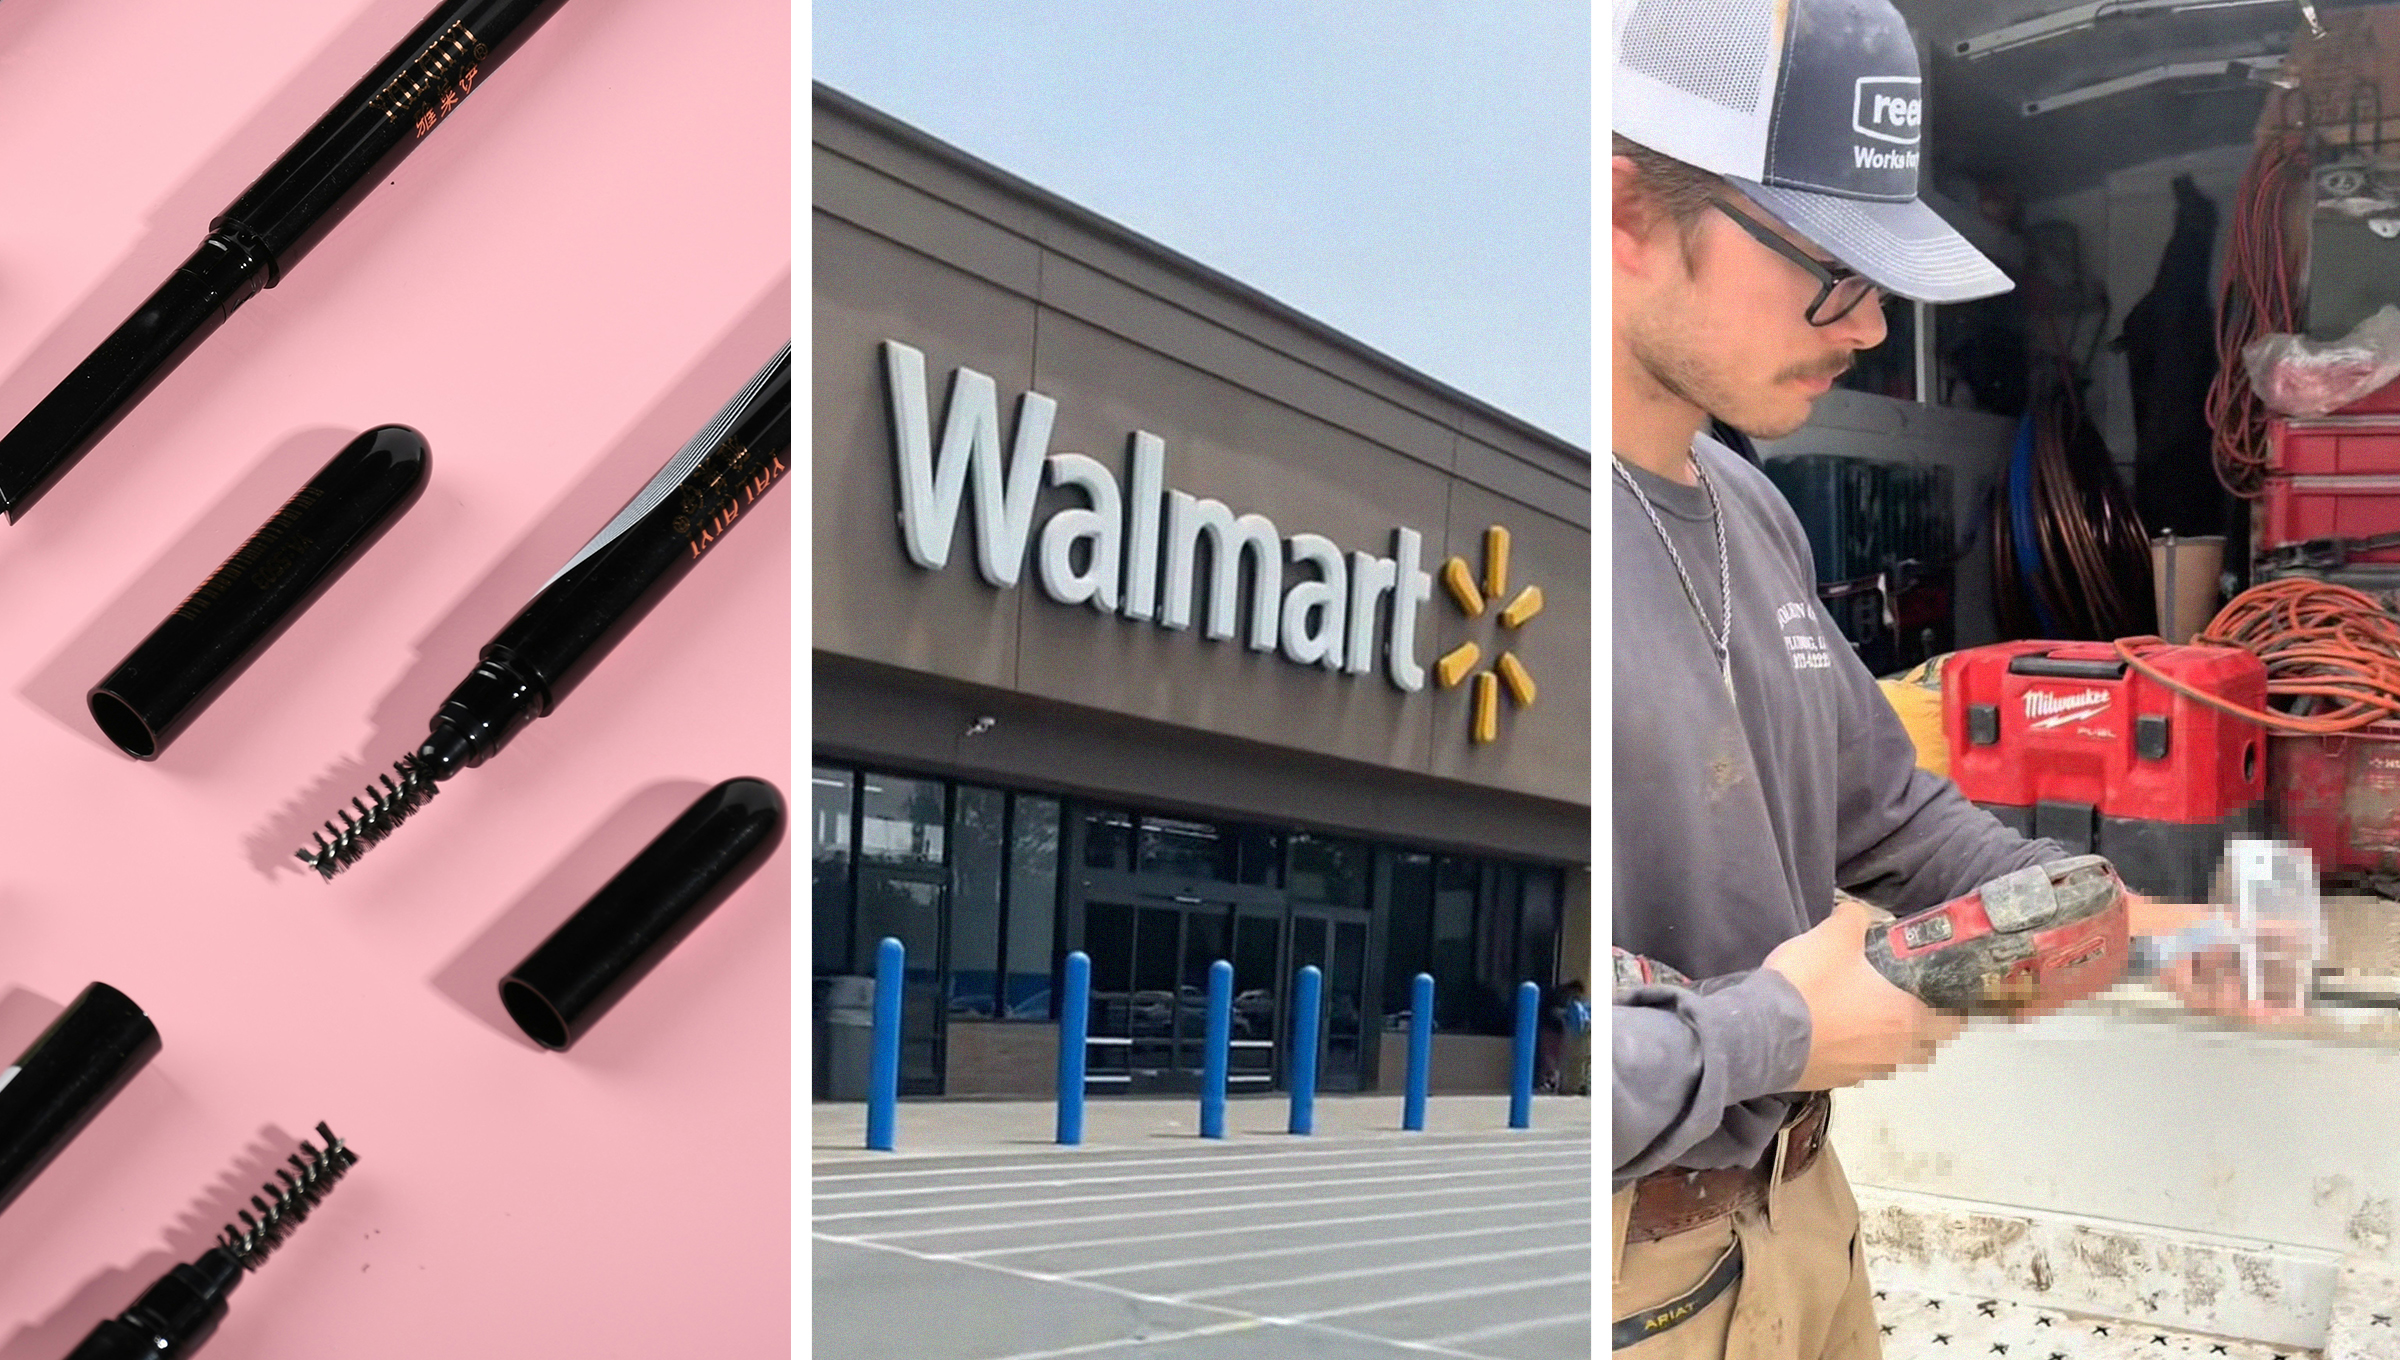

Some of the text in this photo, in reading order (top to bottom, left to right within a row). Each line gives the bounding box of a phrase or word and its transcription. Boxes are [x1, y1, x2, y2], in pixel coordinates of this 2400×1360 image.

[1872, 93, 1922, 127] ree
[1853, 145, 1905, 170] Works
[882, 338, 1432, 693] Walmart
[2021, 688, 2111, 720] Milwaukee
[1644, 1300, 1698, 1331] ARIAT
